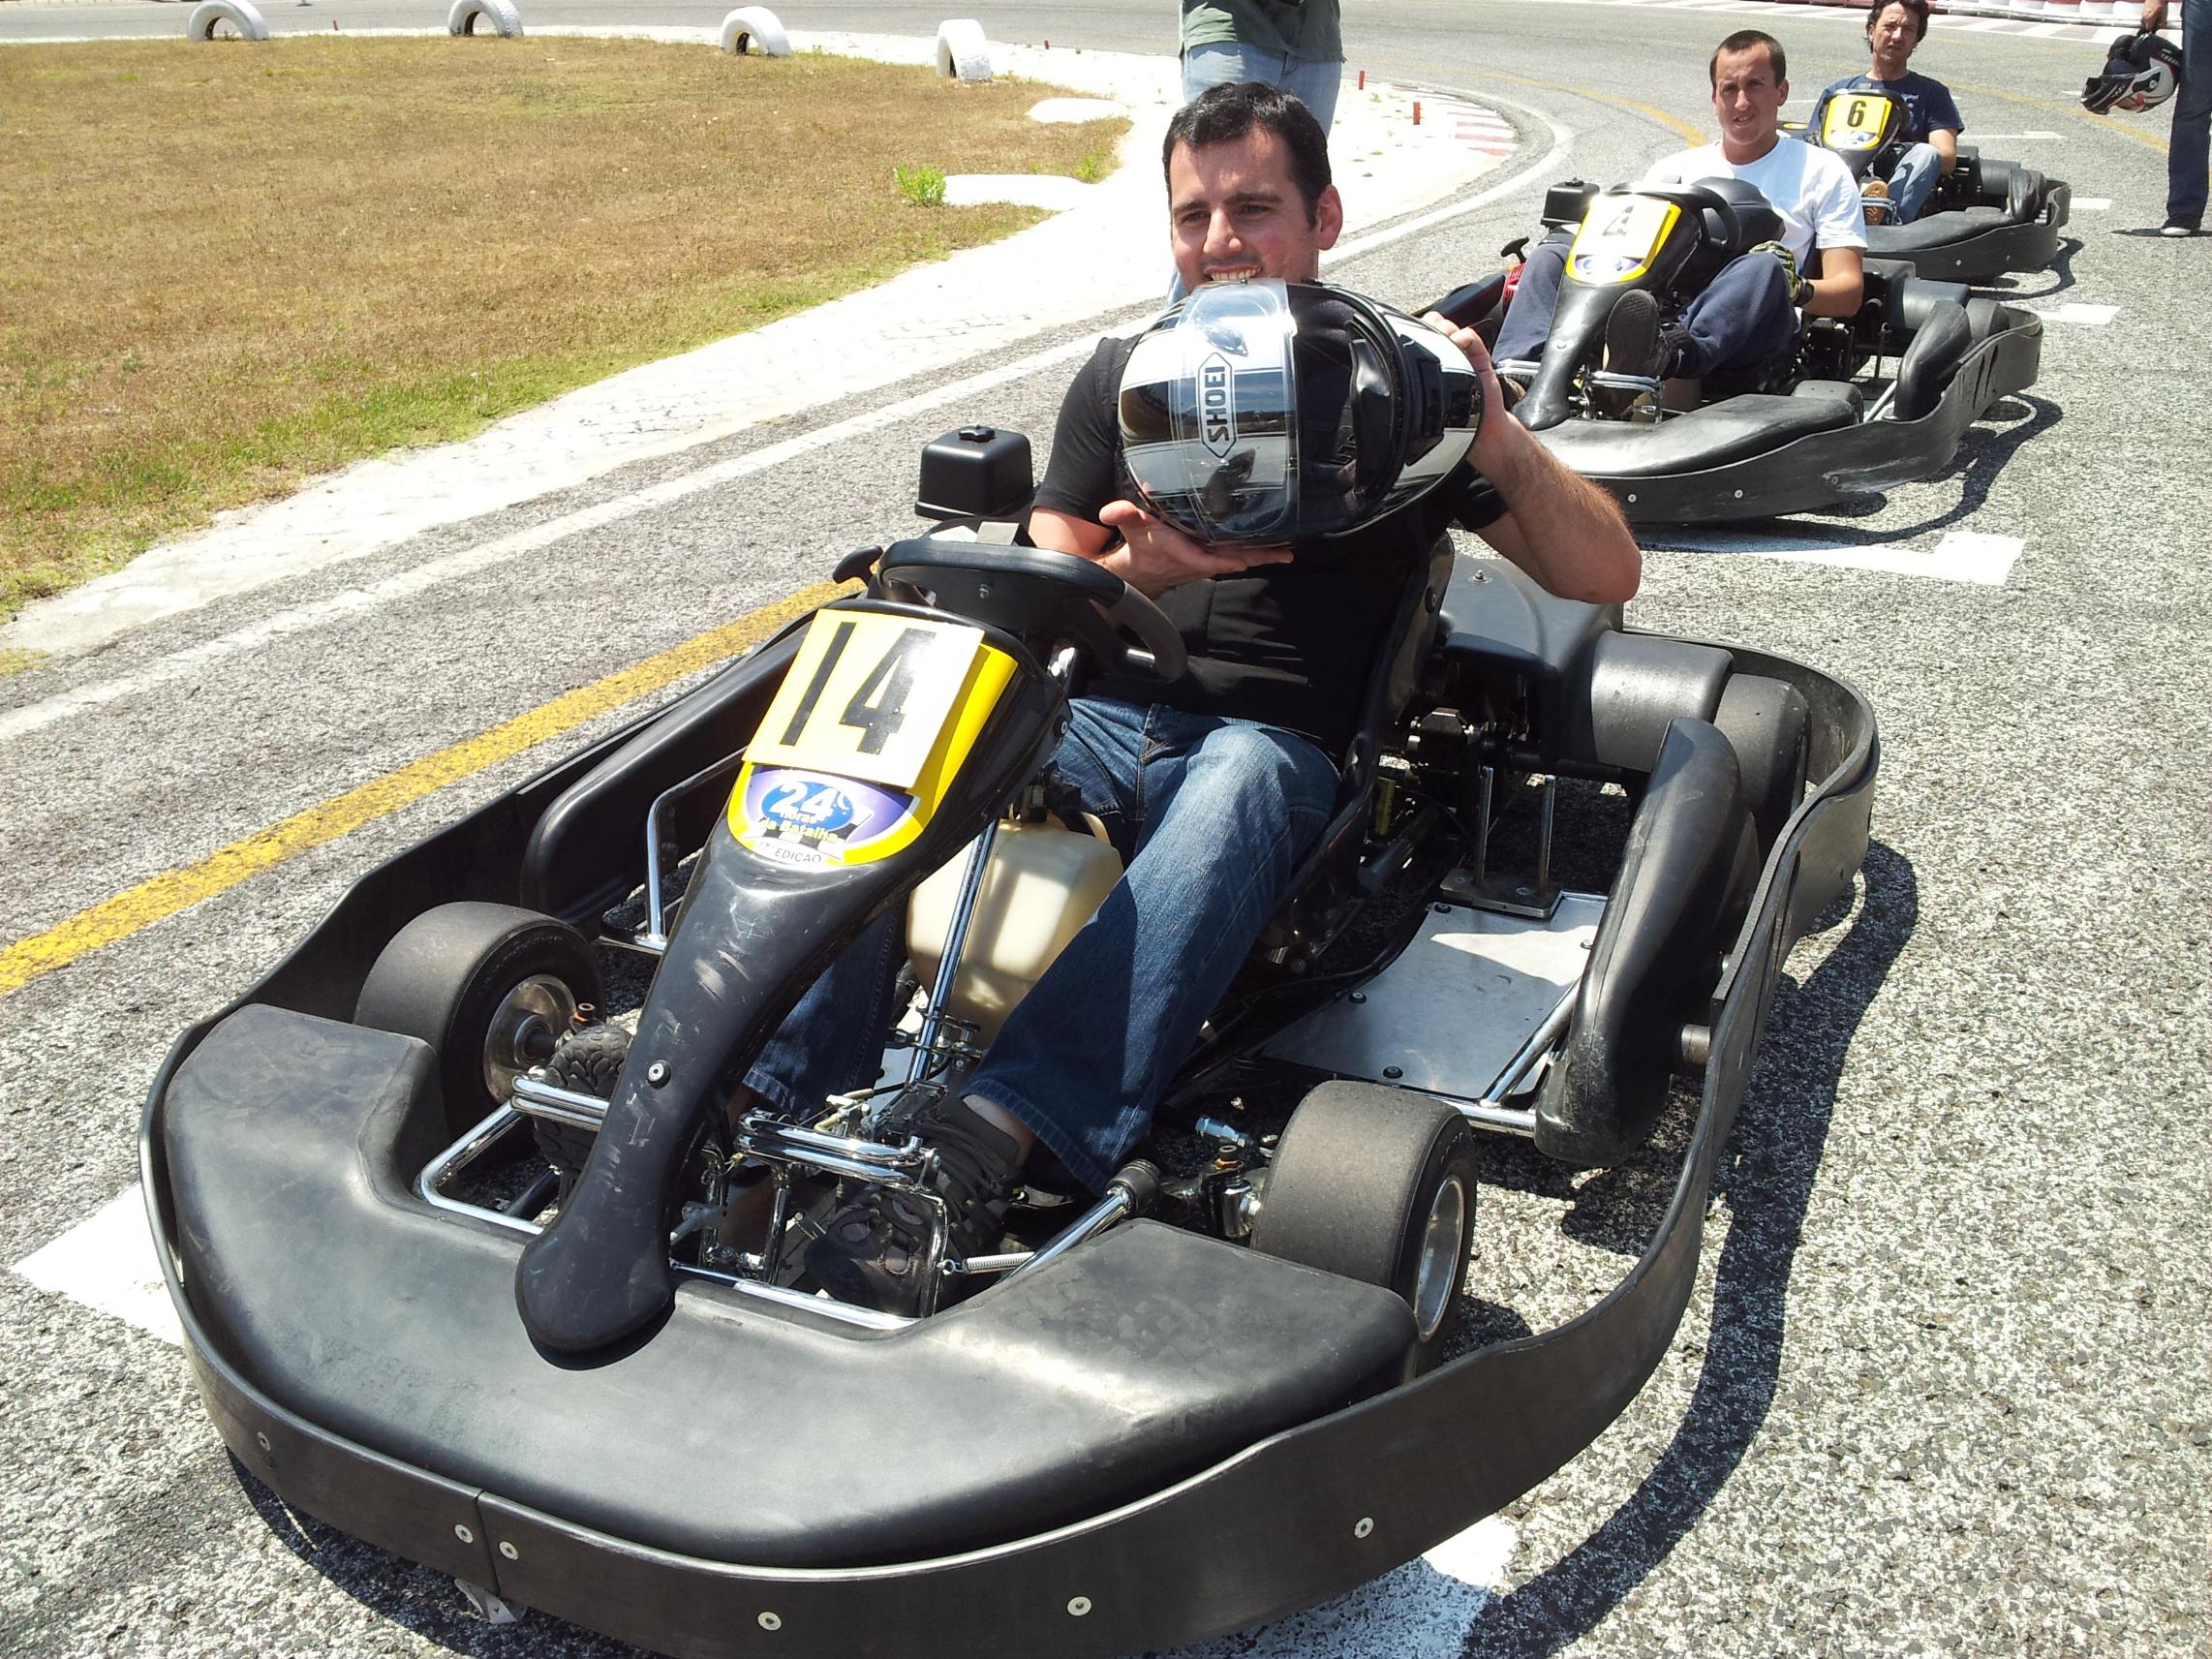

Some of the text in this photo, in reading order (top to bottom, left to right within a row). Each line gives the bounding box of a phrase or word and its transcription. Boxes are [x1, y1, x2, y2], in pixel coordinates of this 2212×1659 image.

[1847, 100, 1867, 128] 6
[1205, 365, 1229, 444] SHOEI
[778, 621, 937, 755] 14
[768, 781, 840, 822] 24
[780, 819, 839, 843] Batalha
